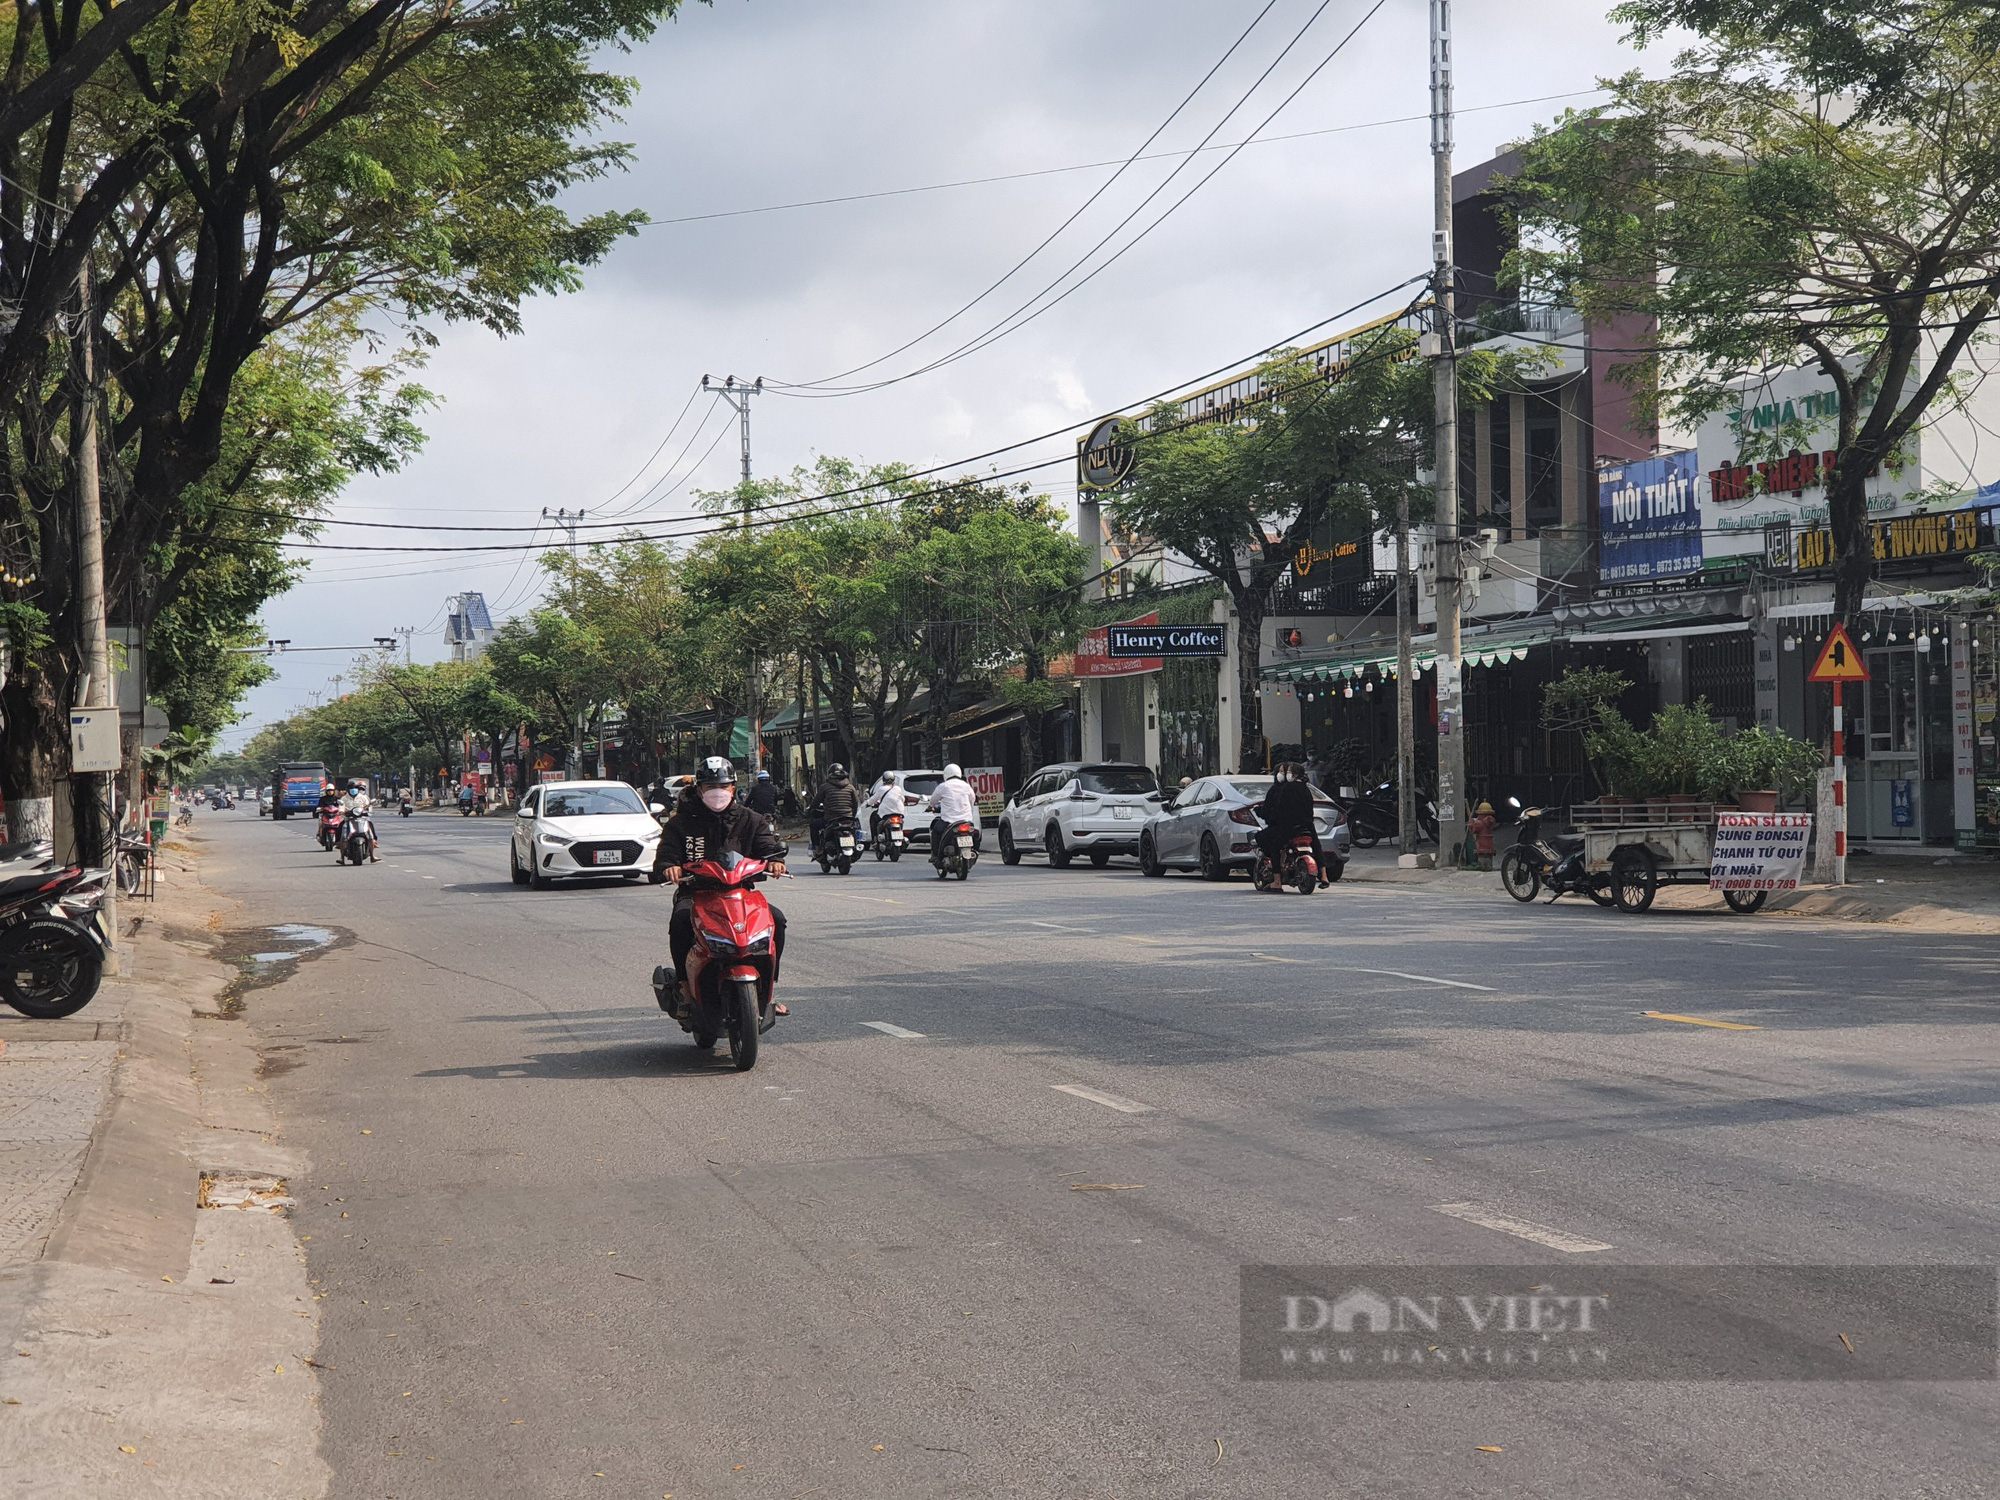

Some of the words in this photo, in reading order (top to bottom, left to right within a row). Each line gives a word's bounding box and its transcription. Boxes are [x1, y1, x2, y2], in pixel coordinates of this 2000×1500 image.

[1708, 460, 1754, 502] TÂM
[1612, 481, 1641, 528] NỘI
[1645, 468, 1688, 519] THẤT
[1873, 522, 1886, 560] &
[1115, 633, 1165, 650] Henry
[1169, 632, 1219, 646] Coffee
[967, 773, 1003, 794] CƠM
[1780, 816, 1788, 827] &
[1717, 830, 1752, 841] SUNG
[1755, 830, 1804, 841] BONSAI
[1713, 847, 1754, 858] CHANH
[1759, 845, 1775, 858] TỨ
[1777, 846, 1804, 859] QUÝ
[1730, 863, 1764, 877] NHẬT
[1725, 879, 1752, 889] 0908
[1753, 879, 1775, 889] 619
[1777, 879, 1797, 889] 789
